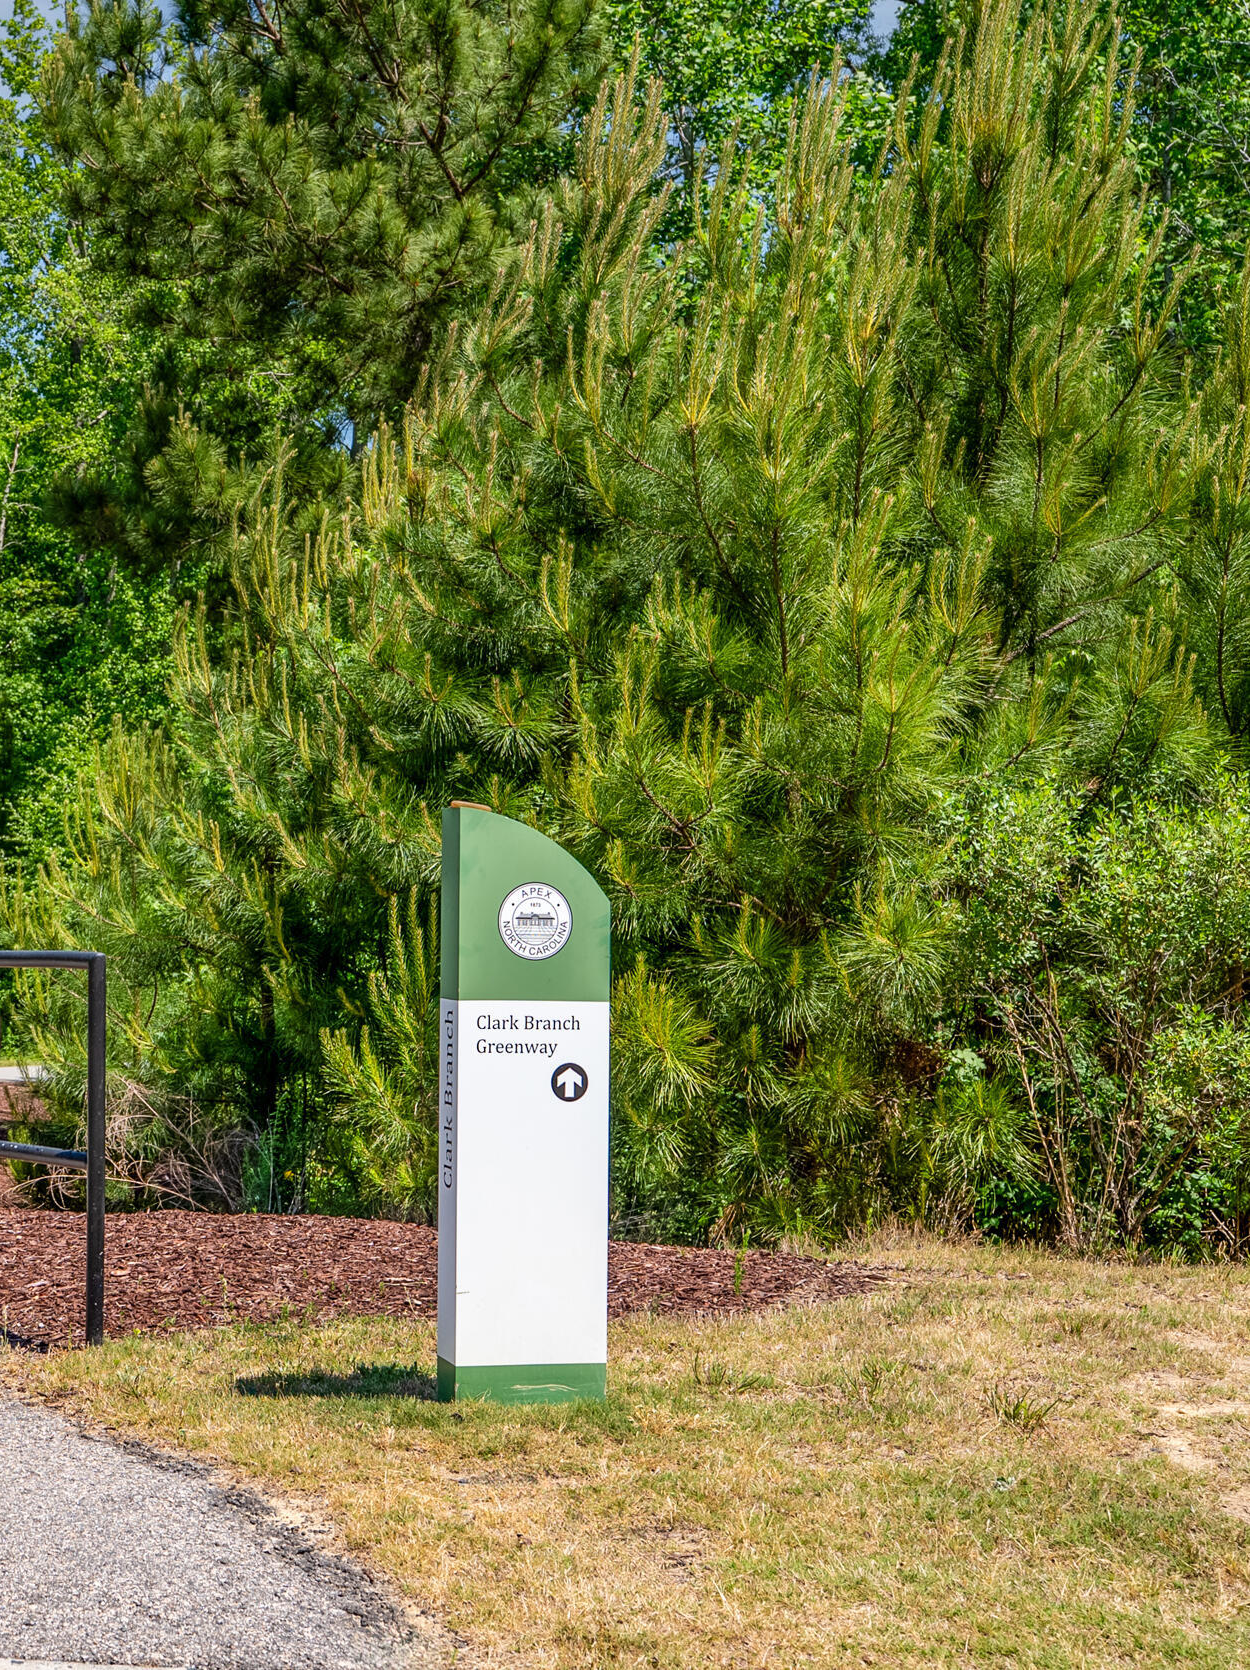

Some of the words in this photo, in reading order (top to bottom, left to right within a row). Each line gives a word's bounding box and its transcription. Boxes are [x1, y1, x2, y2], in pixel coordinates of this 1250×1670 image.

[521, 887, 552, 899] APEX
[503, 920, 527, 954] NORTH
[528, 921, 568, 956] CAROLINA
[476, 1015, 519, 1031] Clark
[524, 1016, 581, 1031] Branch
[444, 1010, 454, 1107] Branch
[476, 1039, 558, 1058] Greenway
[443, 1118, 454, 1189] Clark
